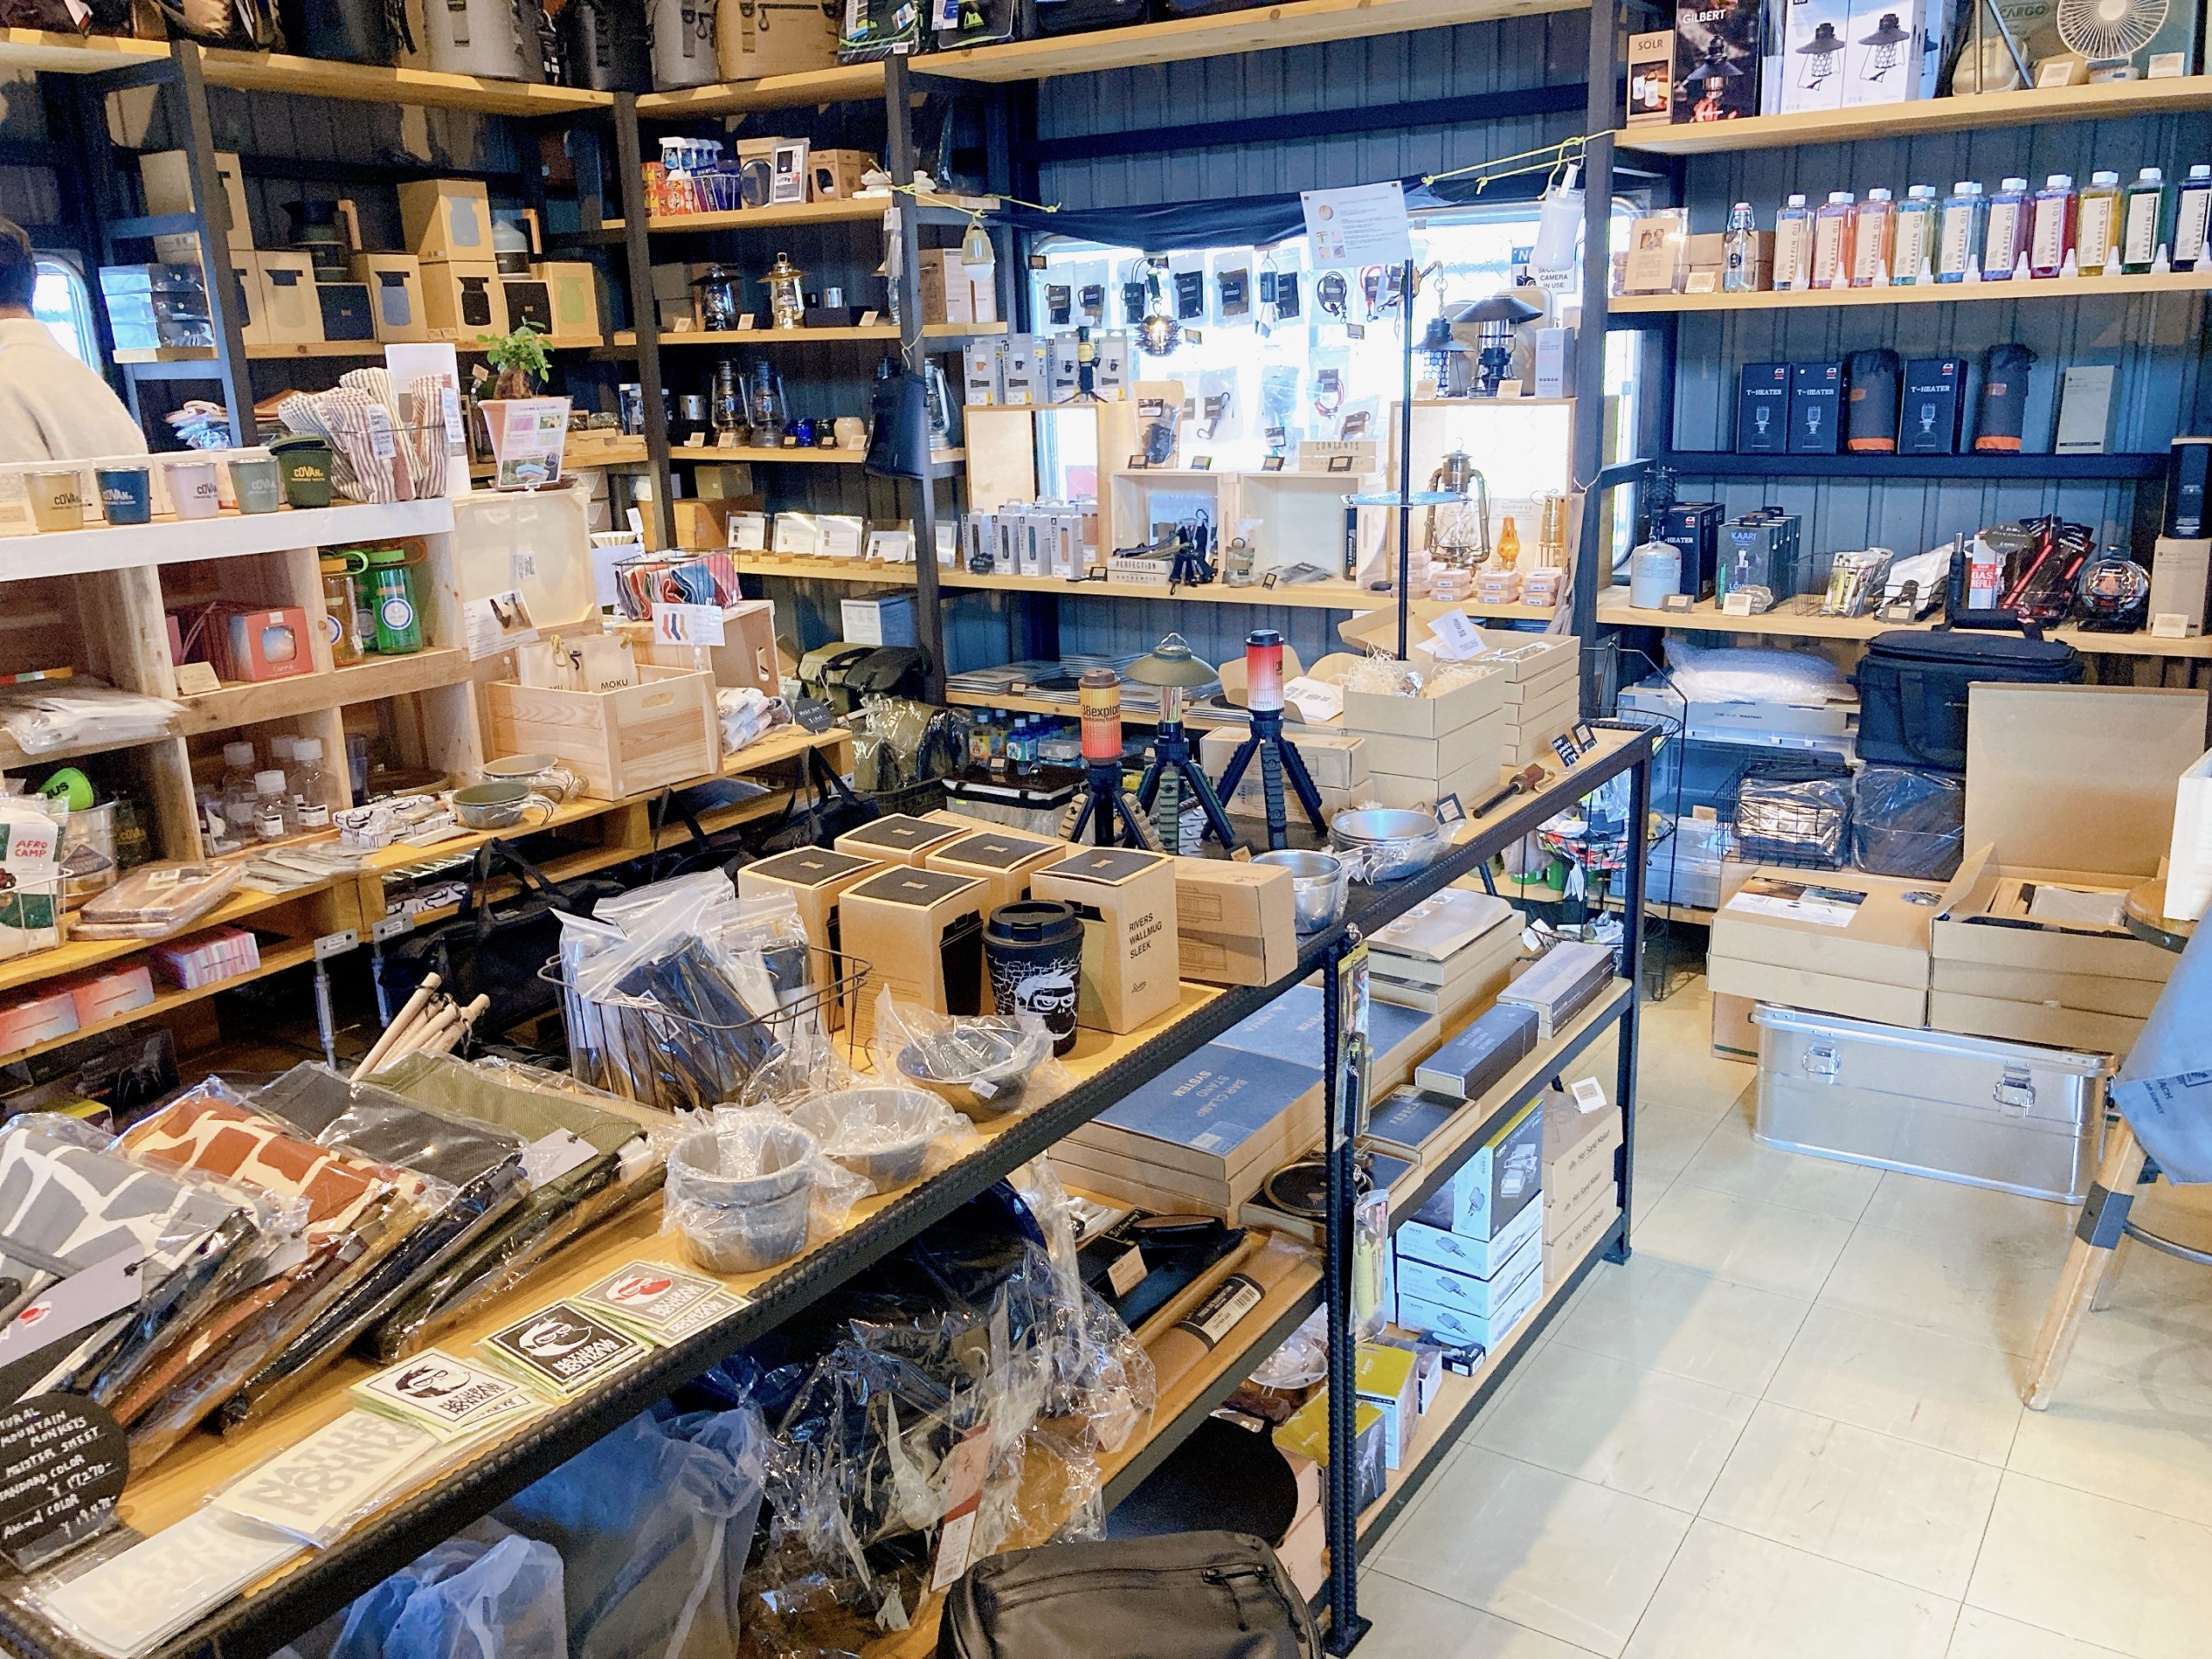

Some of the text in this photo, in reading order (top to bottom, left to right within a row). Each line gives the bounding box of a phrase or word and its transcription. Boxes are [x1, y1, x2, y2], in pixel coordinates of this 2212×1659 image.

[1683, 9, 1726, 24] GILBERT
[2001, 225, 2011, 268] PARAFFIN
[2050, 220, 2058, 264] PARAFFIN
[2096, 220, 2105, 264] PARAFFIN
[2143, 216, 2152, 261] PARAFFIN
[2194, 212, 2204, 257] PARAFFIN
[1788, 240, 1796, 279] PARAFFIN
[1829, 238, 1838, 277] PARAFFIN
[1870, 234, 1878, 276] PARAFFIN
[1910, 233, 1918, 274] PARAFFIN
[1956, 227, 1966, 270] PARAFFIN
[1316, 442, 1360, 452] CONTENTS
[1731, 531, 1757, 540] KAARI
[1116, 561, 1156, 569] PERFECTION
[601, 679, 628, 690] MOKU
[15, 849, 47, 858] CAMP
[16, 840, 48, 849] AFRO
[1128, 912, 1154, 932] RIVERS
[1129, 921, 1162, 945] WALLMUG
[1130, 940, 1152, 959] SLEEK
[1170, 1070, 1211, 1097] SYSTEM
[1195, 1074, 1230, 1099] STAND
[1578, 1150, 1586, 1162] Hot
[1586, 1141, 1598, 1155] Sand
[1, 1410, 67, 1447] MOUNTAIN
[30, 1416, 86, 1447] MONKEYS
[60, 1427, 98, 1452] SHEET
[238, 1413, 384, 1503] NATUR
[0, 1454, 86, 1502] TANDARD COLOR
[47, 1493, 79, 1516] COLOR
